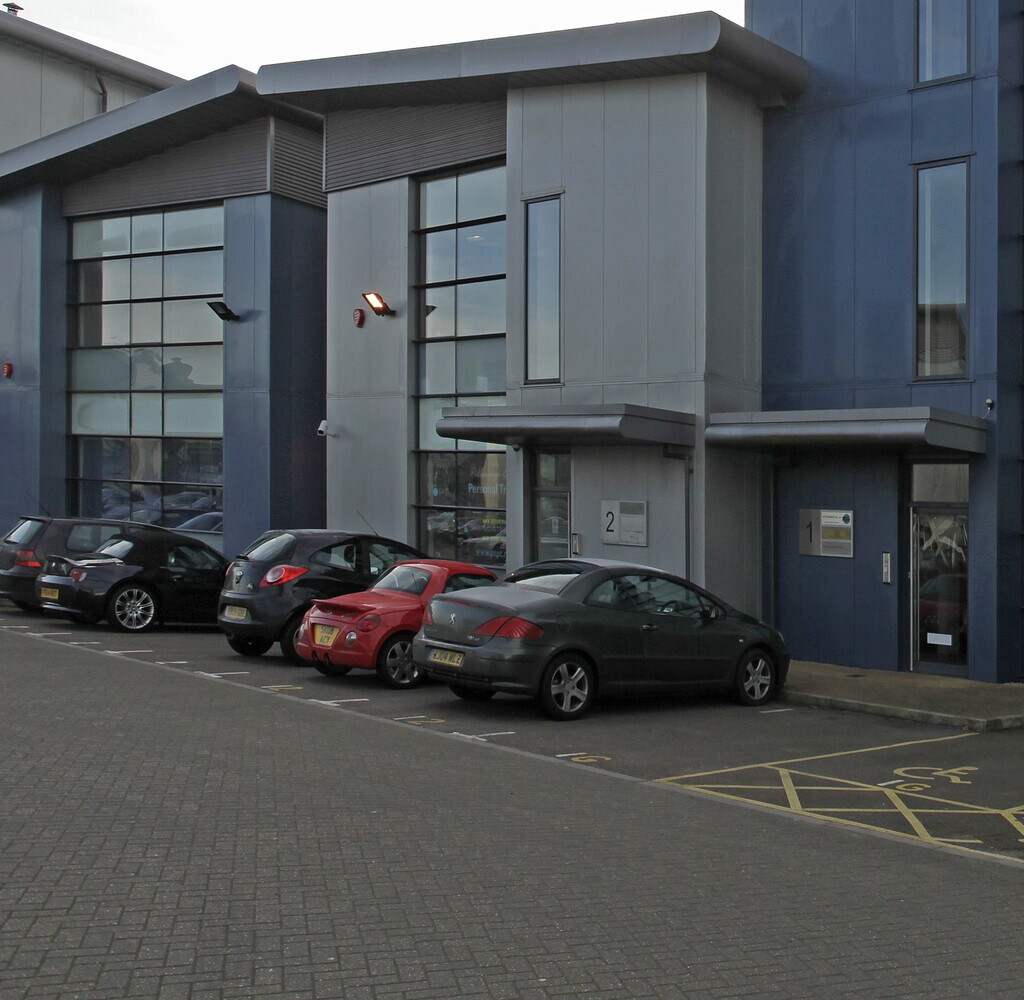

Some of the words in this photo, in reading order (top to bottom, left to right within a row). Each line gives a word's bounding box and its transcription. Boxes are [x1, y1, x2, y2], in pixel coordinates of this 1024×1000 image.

[468, 482, 499, 494] Personal
[606, 511, 615, 533] 2
[806, 521, 813, 544] 1
